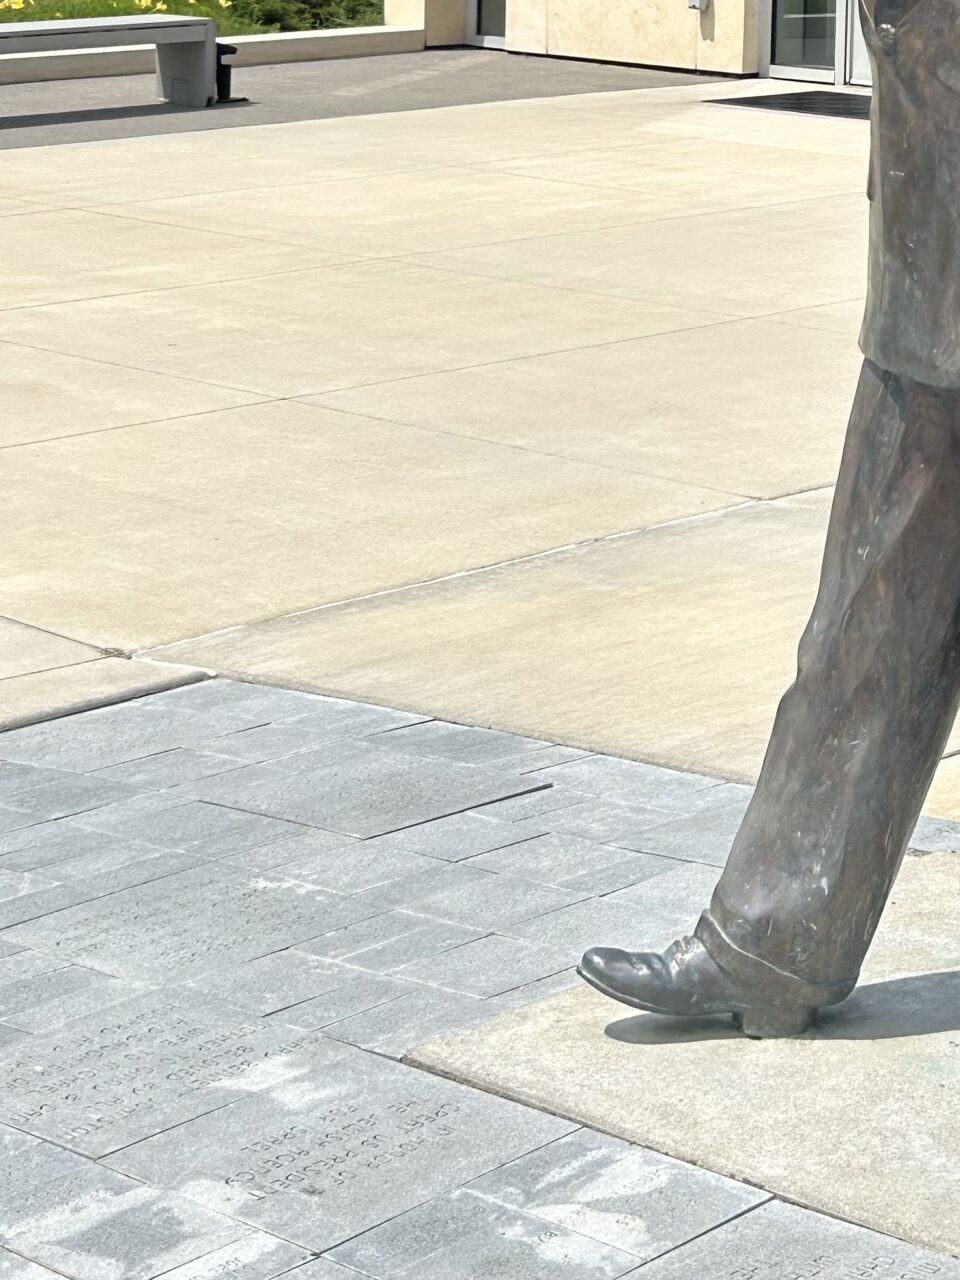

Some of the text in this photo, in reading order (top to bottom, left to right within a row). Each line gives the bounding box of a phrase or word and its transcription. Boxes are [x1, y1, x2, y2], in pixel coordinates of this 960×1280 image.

[238, 1122, 315, 1155] ISRAEL
[220, 1146, 312, 1188] AGENCY
[244, 1148, 361, 1201] PRESIDENT
